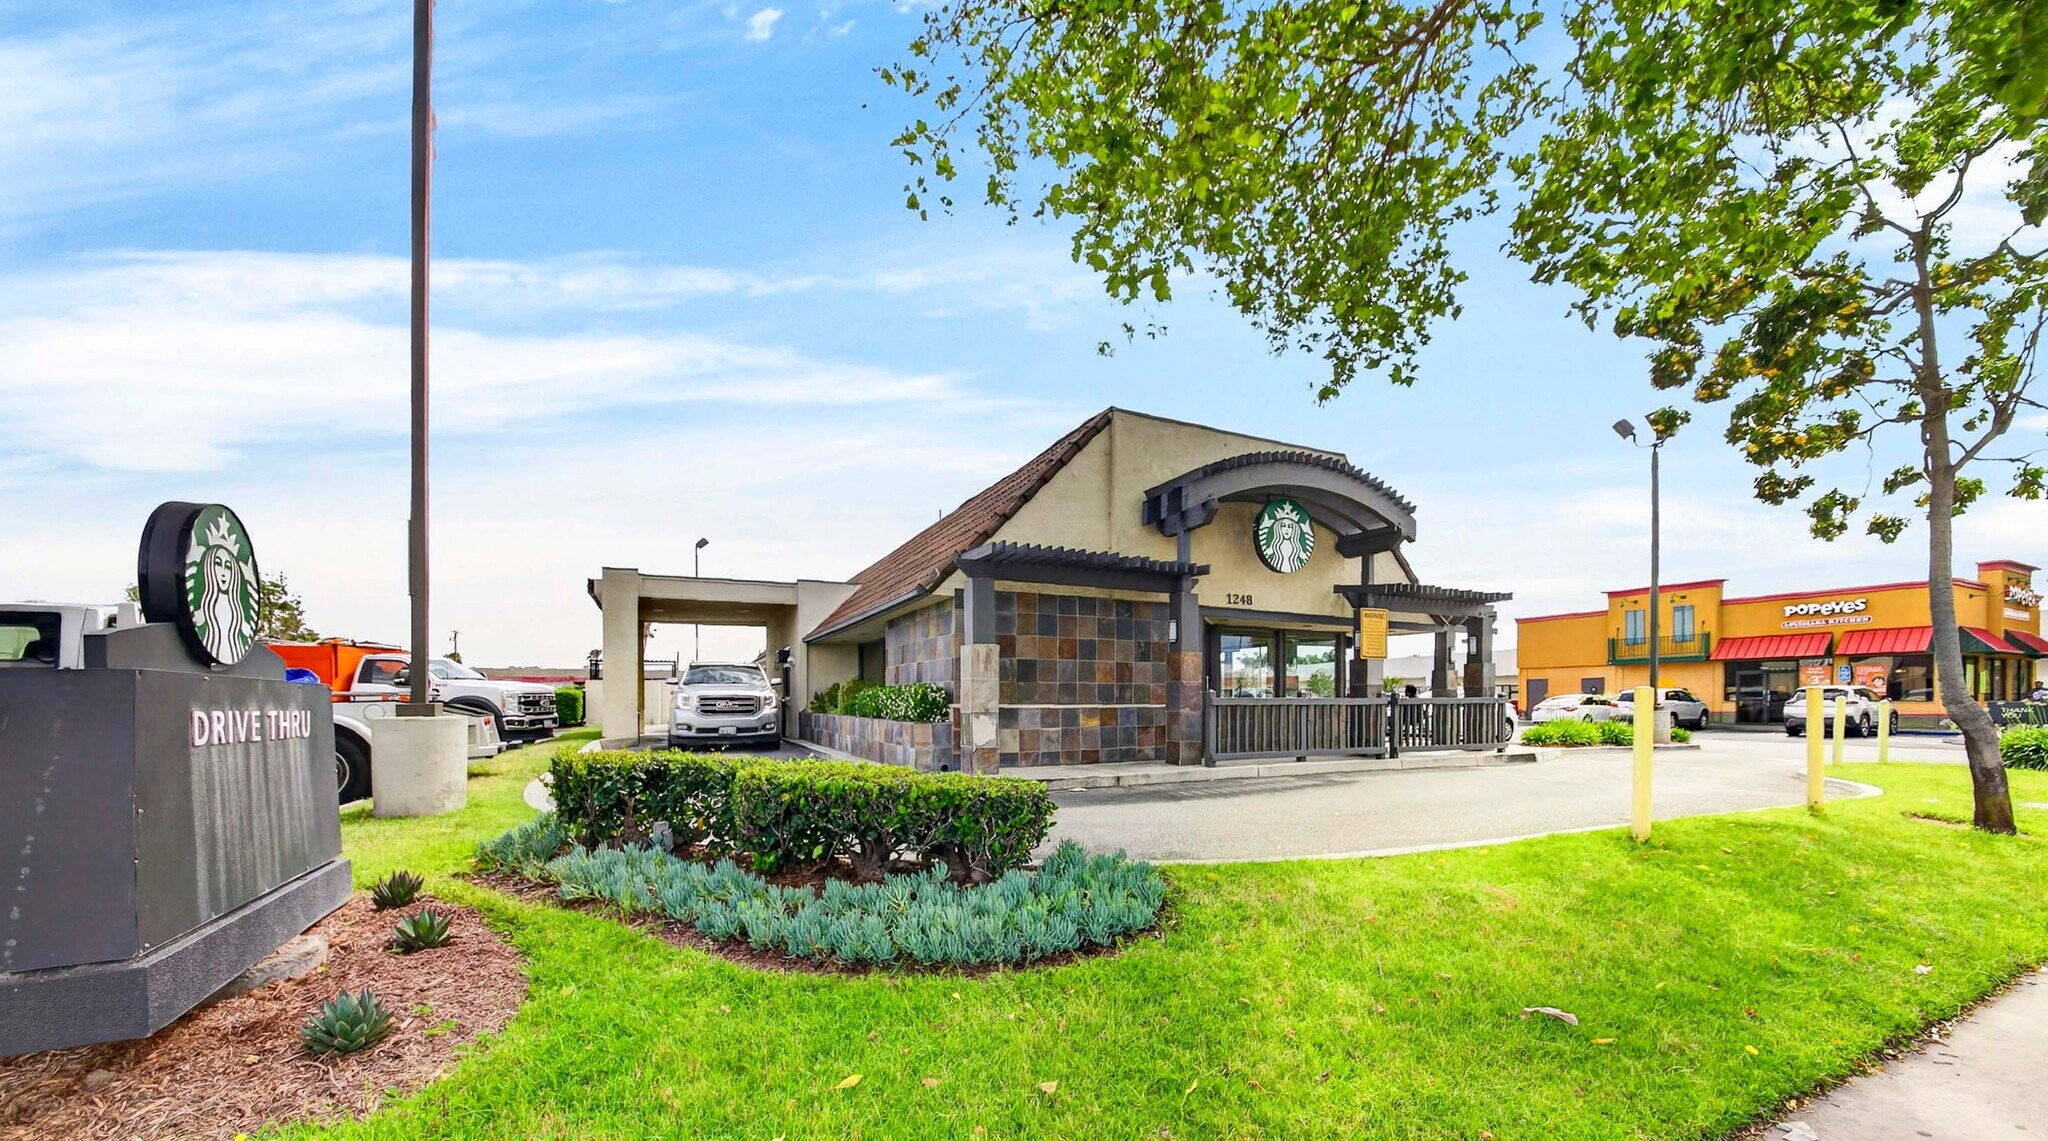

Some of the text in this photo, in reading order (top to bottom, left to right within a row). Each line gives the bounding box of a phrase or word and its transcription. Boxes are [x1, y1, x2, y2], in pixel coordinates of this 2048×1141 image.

[1226, 593, 1253, 605] 1248
[1828, 616, 1869, 625] KITCHEN
[192, 710, 311, 747] DRIVE THRU
